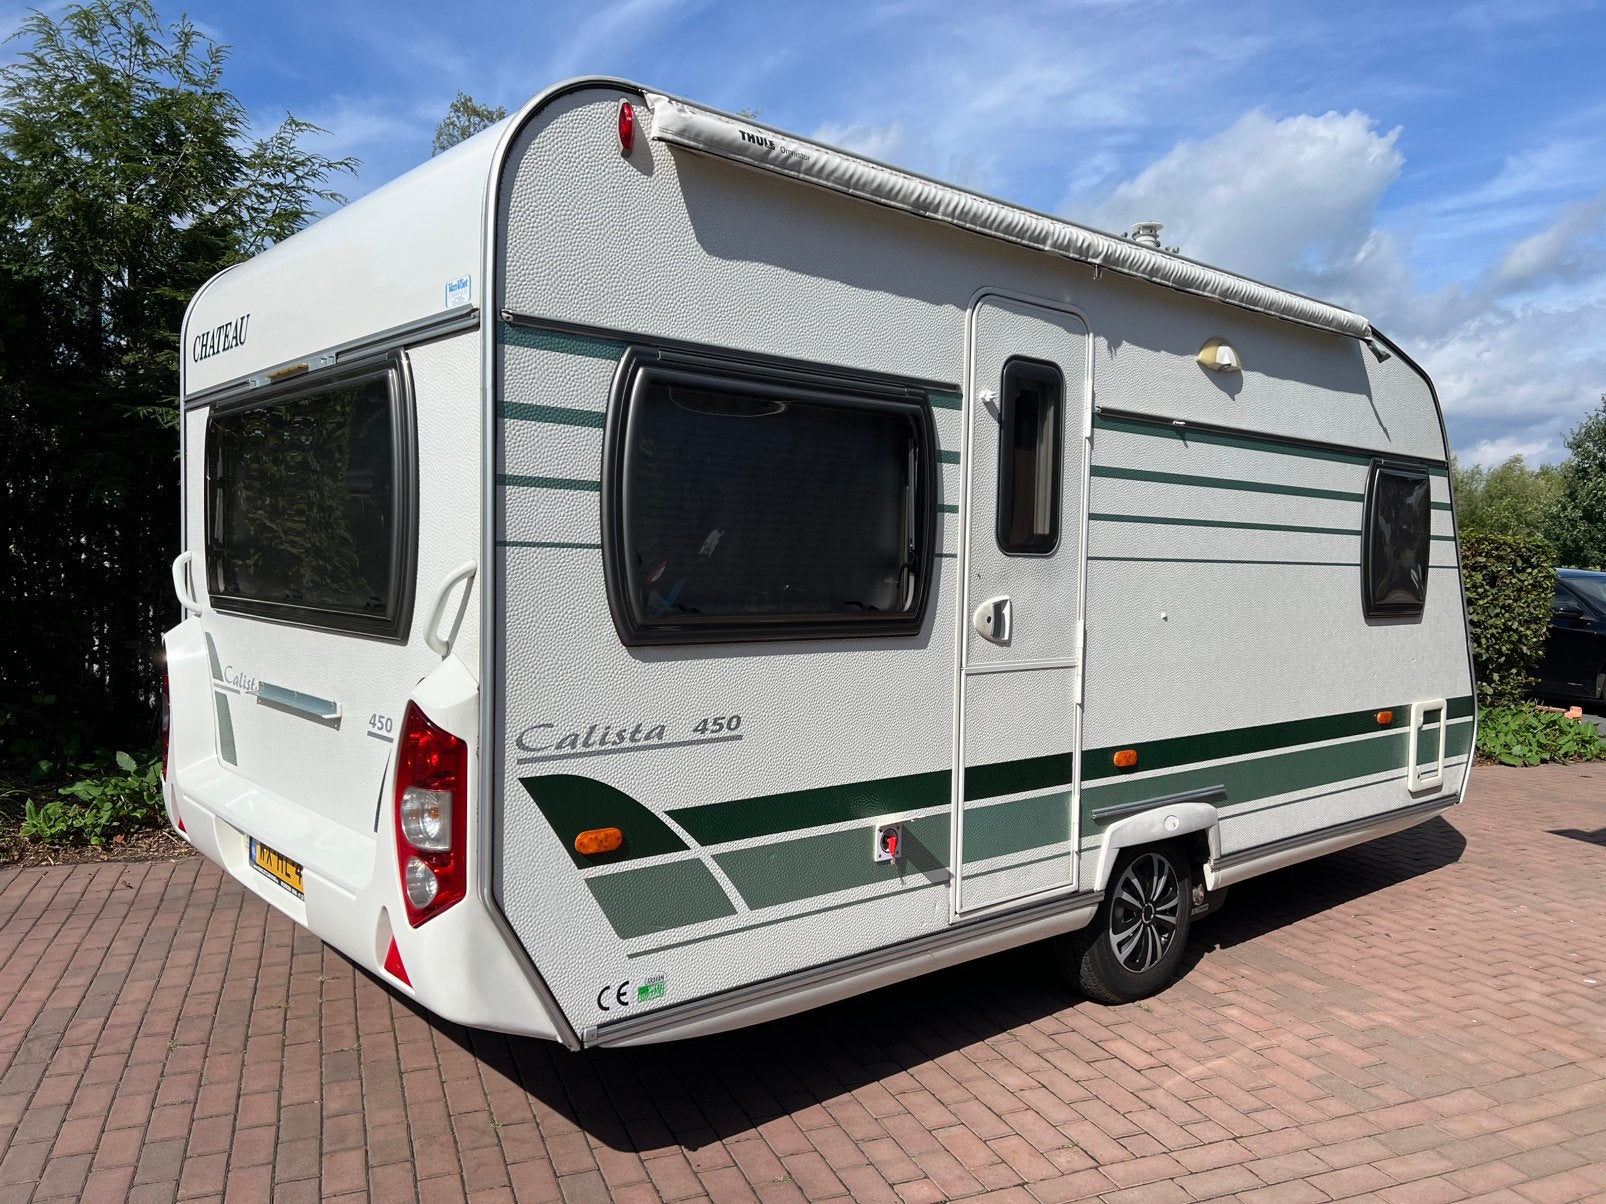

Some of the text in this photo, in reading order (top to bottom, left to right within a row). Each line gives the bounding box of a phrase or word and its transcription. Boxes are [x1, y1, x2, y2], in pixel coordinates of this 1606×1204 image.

[738, 129, 776, 151] THULE
[193, 313, 251, 363] CHATEAU
[368, 712, 394, 733] 450
[515, 714, 743, 752] Calista 450
[597, 980, 630, 1012] CE
